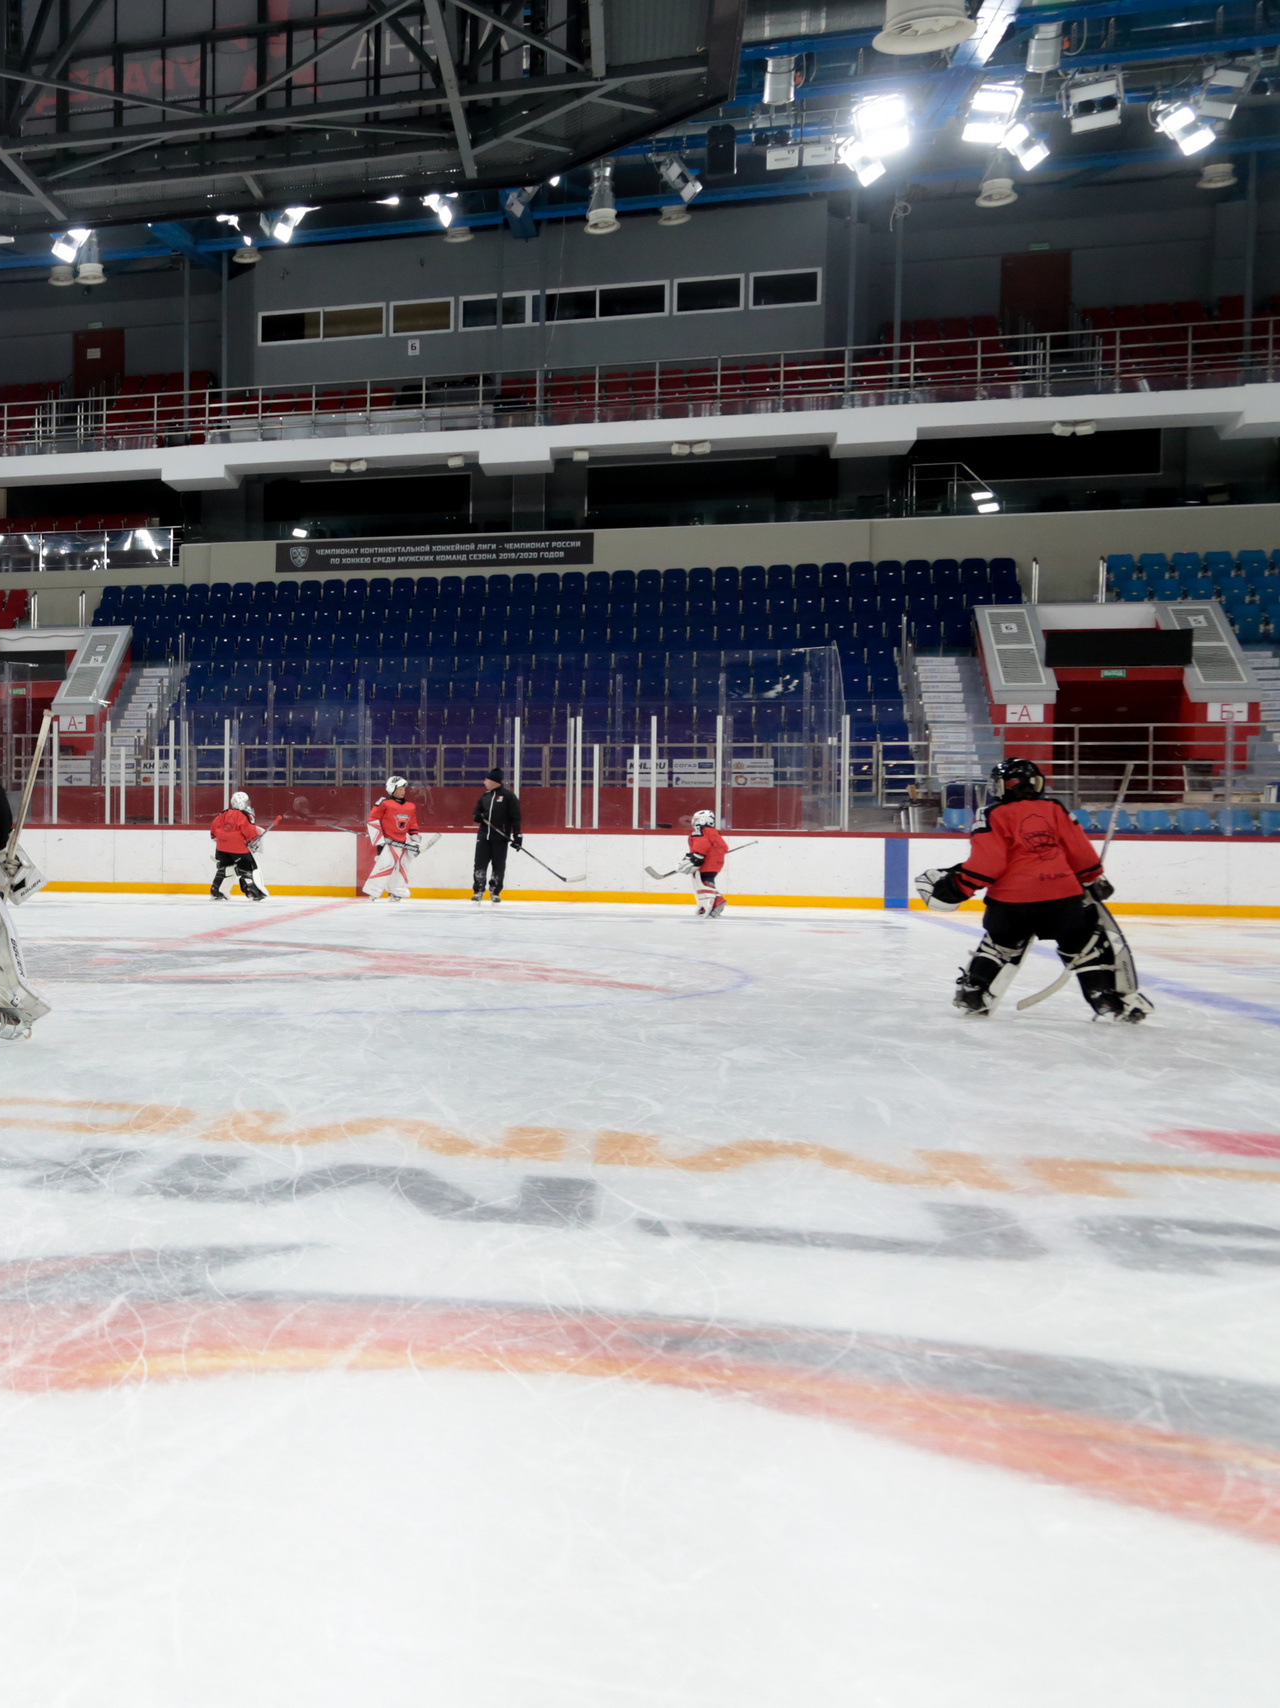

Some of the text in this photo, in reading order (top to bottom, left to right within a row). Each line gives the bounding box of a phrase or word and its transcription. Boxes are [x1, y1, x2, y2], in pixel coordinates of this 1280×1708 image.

[315, 547, 358, 556] ЧЕМПИОНАТ
[360, 544, 430, 555] КОНТИНЕНТАЛЬНОЙ
[432, 543, 475, 552] ХОККЕЙНОЙ
[477, 543, 497, 551] ЛИГИ
[504, 542, 549, 550] ЧЕМПИОНАТ
[372, 556, 396, 564] СРЕДИ
[397, 555, 434, 563] МУЖСКИХ
[435, 554, 467, 562] КОМАНД
[498, 552, 538, 560] 2019/2020
[539, 551, 564, 559] ГОДОВ
